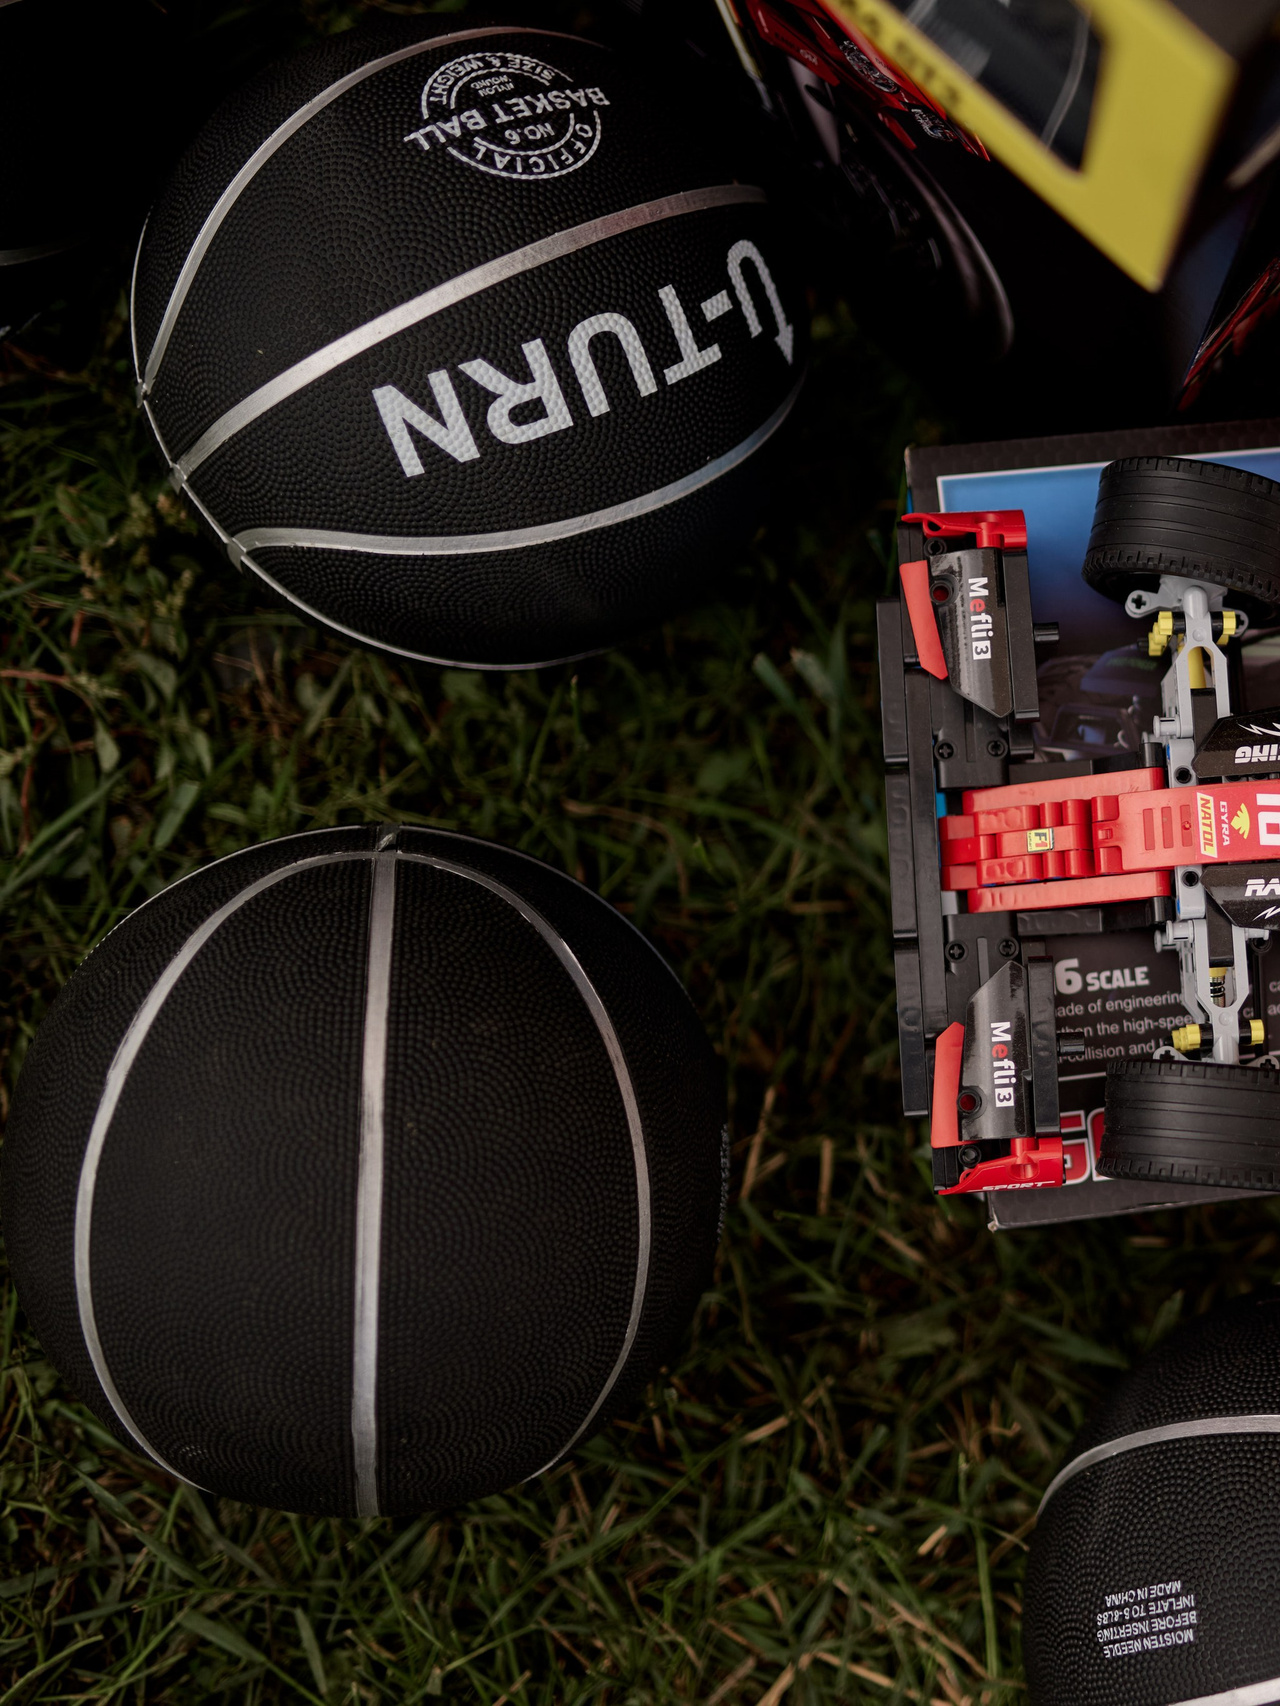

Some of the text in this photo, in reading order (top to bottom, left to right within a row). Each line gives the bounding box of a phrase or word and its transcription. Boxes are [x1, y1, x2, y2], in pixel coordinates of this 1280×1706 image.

[429, 55, 556, 106] SIZE & WEIGHT
[477, 82, 515, 97] NYLON
[403, 87, 610, 150] BASKET BALL
[472, 122, 594, 173] OFFICIAL
[504, 122, 556, 145] NO.6
[371, 239, 795, 478] U-TURN
[1198, 796, 1215, 853] NATOL
[1219, 800, 1231, 846] GYRA
[1085, 965, 1150, 993] SCALE
[1055, 1001, 1084, 1017] ade
[1088, 997, 1102, 1014] of
[1105, 990, 1184, 1013] engineerin
[1096, 1021, 1119, 1036] the
[1123, 1014, 1194, 1034] high-spee
[1128, 1039, 1156, 1055] and
[981, 1181, 1055, 1191] SPORT
[1104, 1579, 1181, 1607] MADE IN CHINA
[1147, 1594, 1195, 1615] INFLATE
[1131, 1603, 1147, 1618] TO
[1096, 1610, 1197, 1643] BEFORE INSERTING
[1102, 1628, 1194, 1659] MOISTEN NEEDLE
